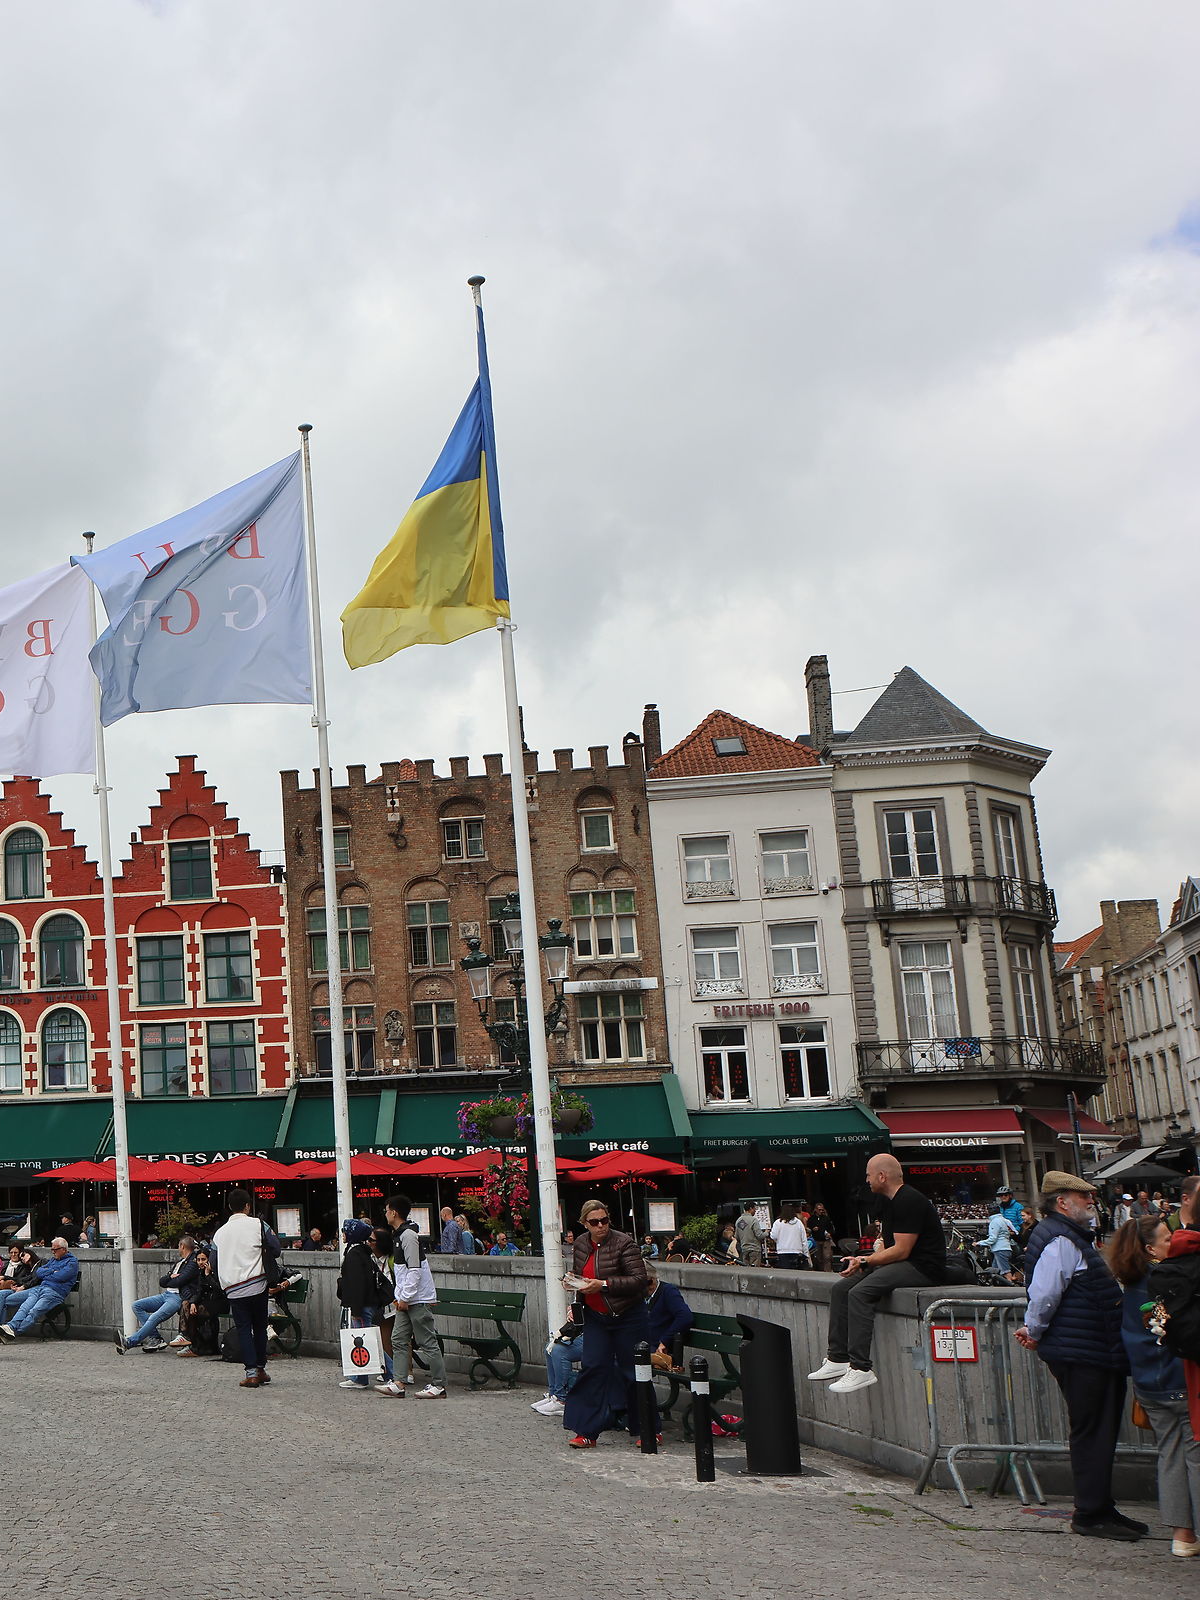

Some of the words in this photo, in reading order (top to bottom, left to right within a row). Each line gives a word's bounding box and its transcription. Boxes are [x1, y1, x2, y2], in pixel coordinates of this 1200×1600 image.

[713, 1003, 775, 1017] FRITERIE
[778, 1001, 811, 1015] 1900
[588, 1141, 620, 1152] Petit
[621, 1140, 650, 1152] café
[703, 1139, 721, 1147] FRIET
[722, 1139, 749, 1147] BURGER
[791, 1137, 809, 1145] BEER
[848, 1135, 870, 1143] ROOM
[920, 1137, 990, 1147] CHOCOLATE
[164, 1153, 207, 1165] DES
[211, 1150, 268, 1164] ARS
[294, 1149, 359, 1159] Restaunt
[386, 1146, 428, 1157] Civiere
[431, 1145, 456, 1156] d'Or
[942, 1164, 990, 1174] CHOCOLATE
[941, 1329, 948, 1338] H
